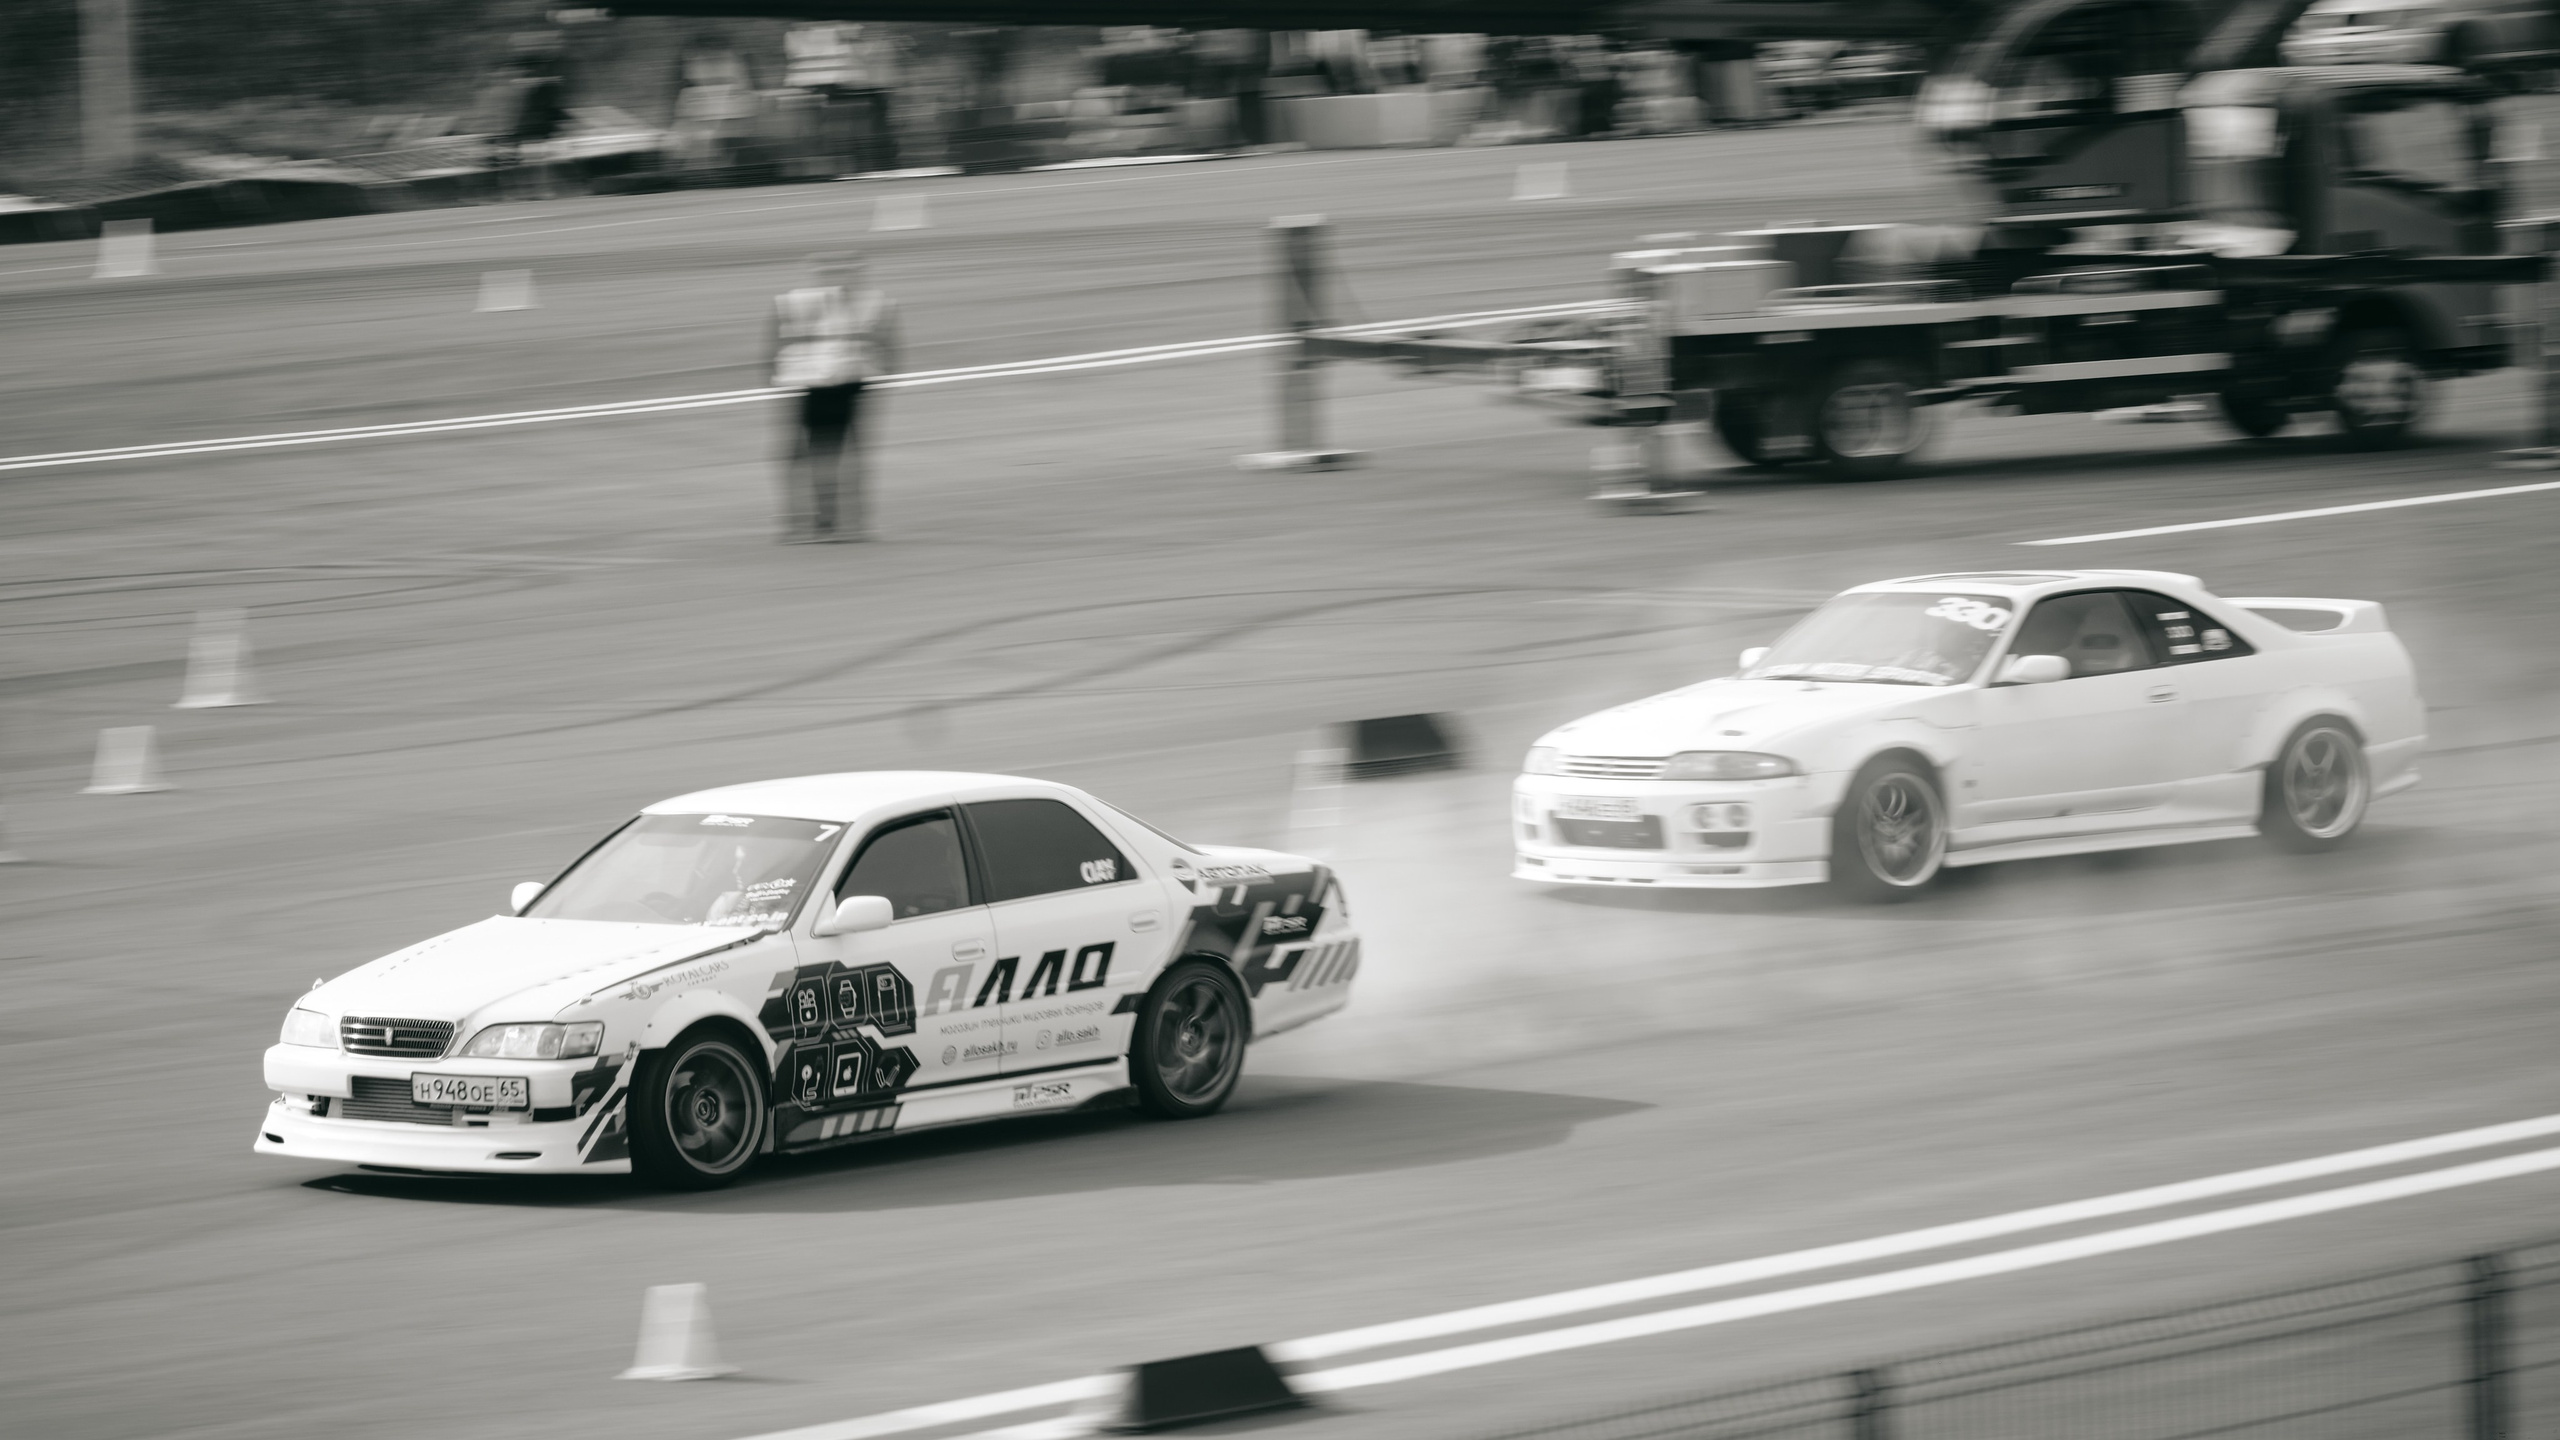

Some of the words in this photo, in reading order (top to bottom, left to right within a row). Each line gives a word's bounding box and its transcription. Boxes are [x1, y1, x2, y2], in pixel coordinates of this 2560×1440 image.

[814, 824, 841, 842] 7
[924, 941, 1116, 1017] АЛЛО
[500, 1080, 520, 1098] 65
